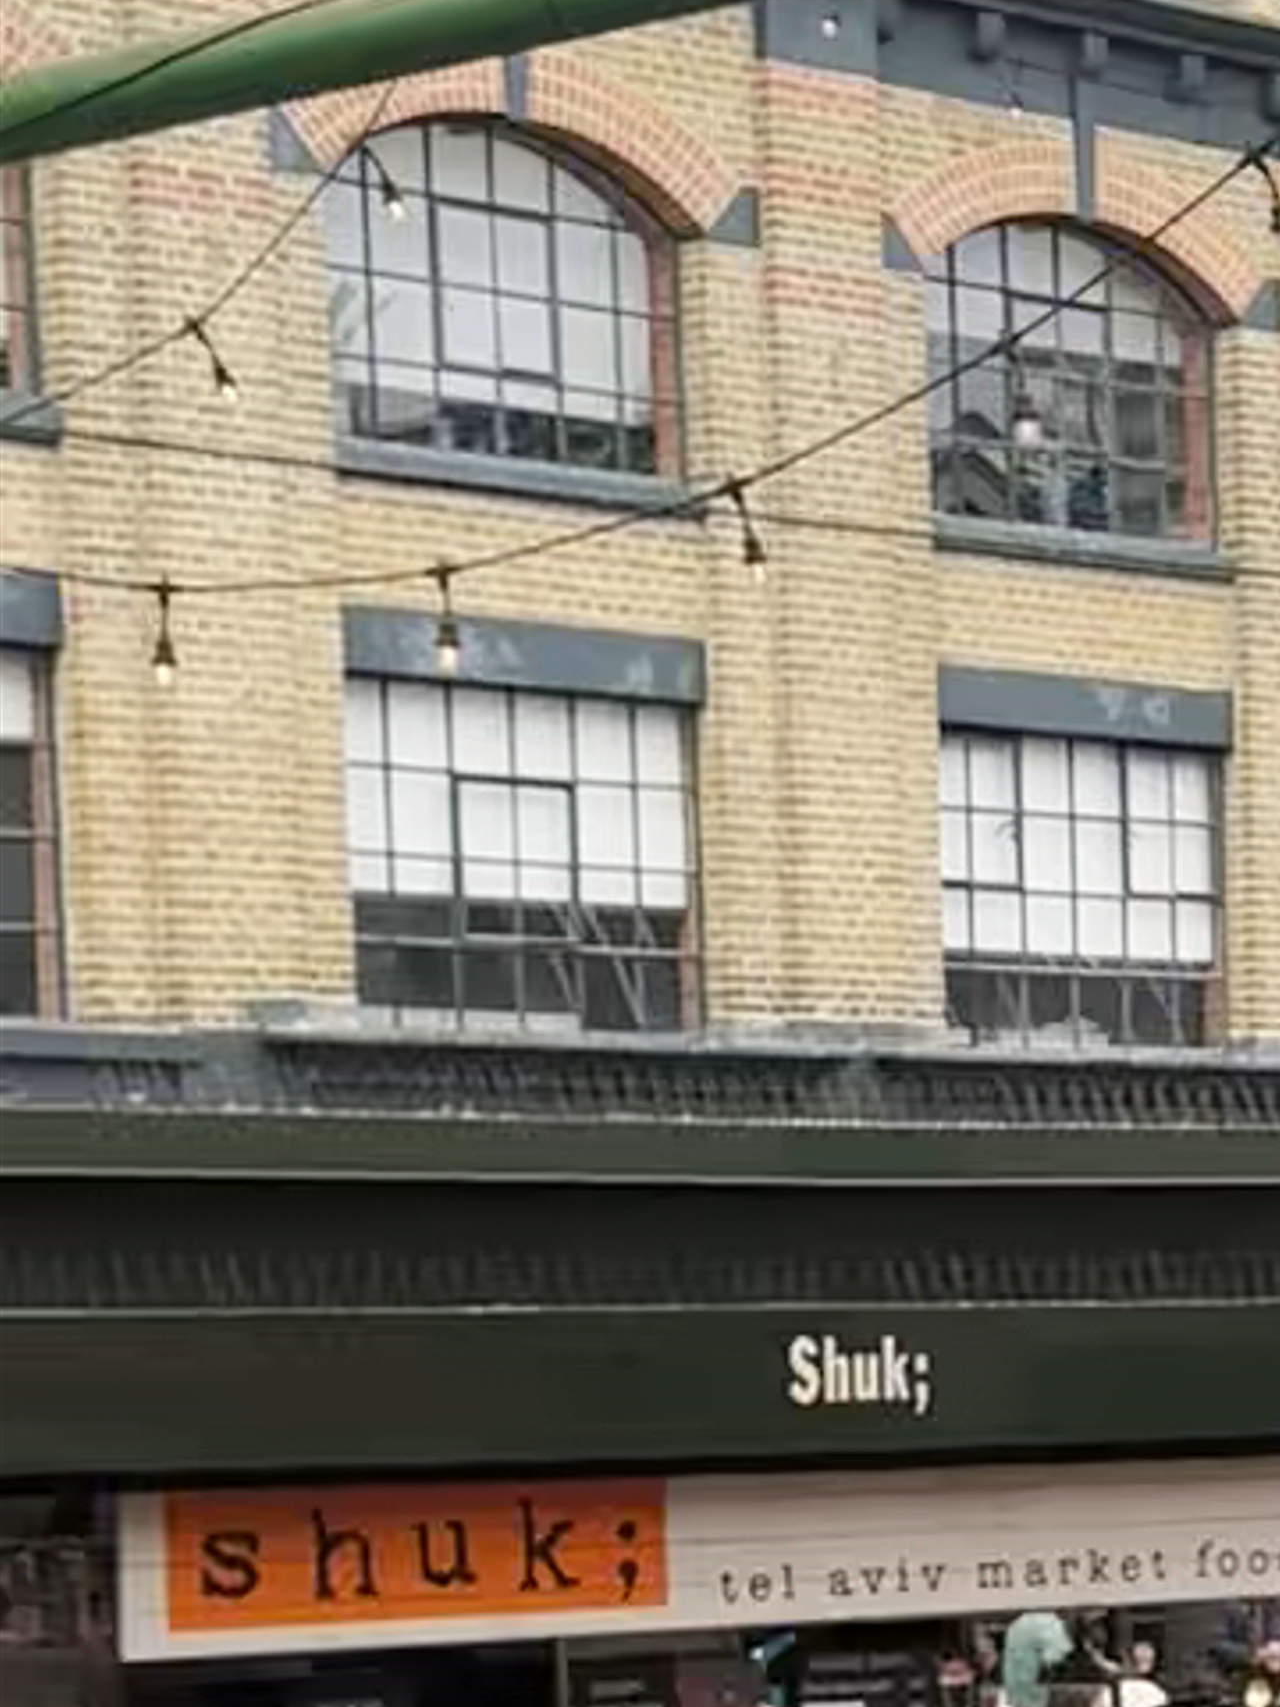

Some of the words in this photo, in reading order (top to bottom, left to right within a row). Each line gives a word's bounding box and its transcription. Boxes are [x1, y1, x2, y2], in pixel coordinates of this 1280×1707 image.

[788, 1334, 930, 1415] Shuk;
[201, 1498, 638, 1602] shuk;
[719, 1563, 796, 1605] tel
[827, 1557, 947, 1597] aviv
[976, 1549, 1166, 1590] market
